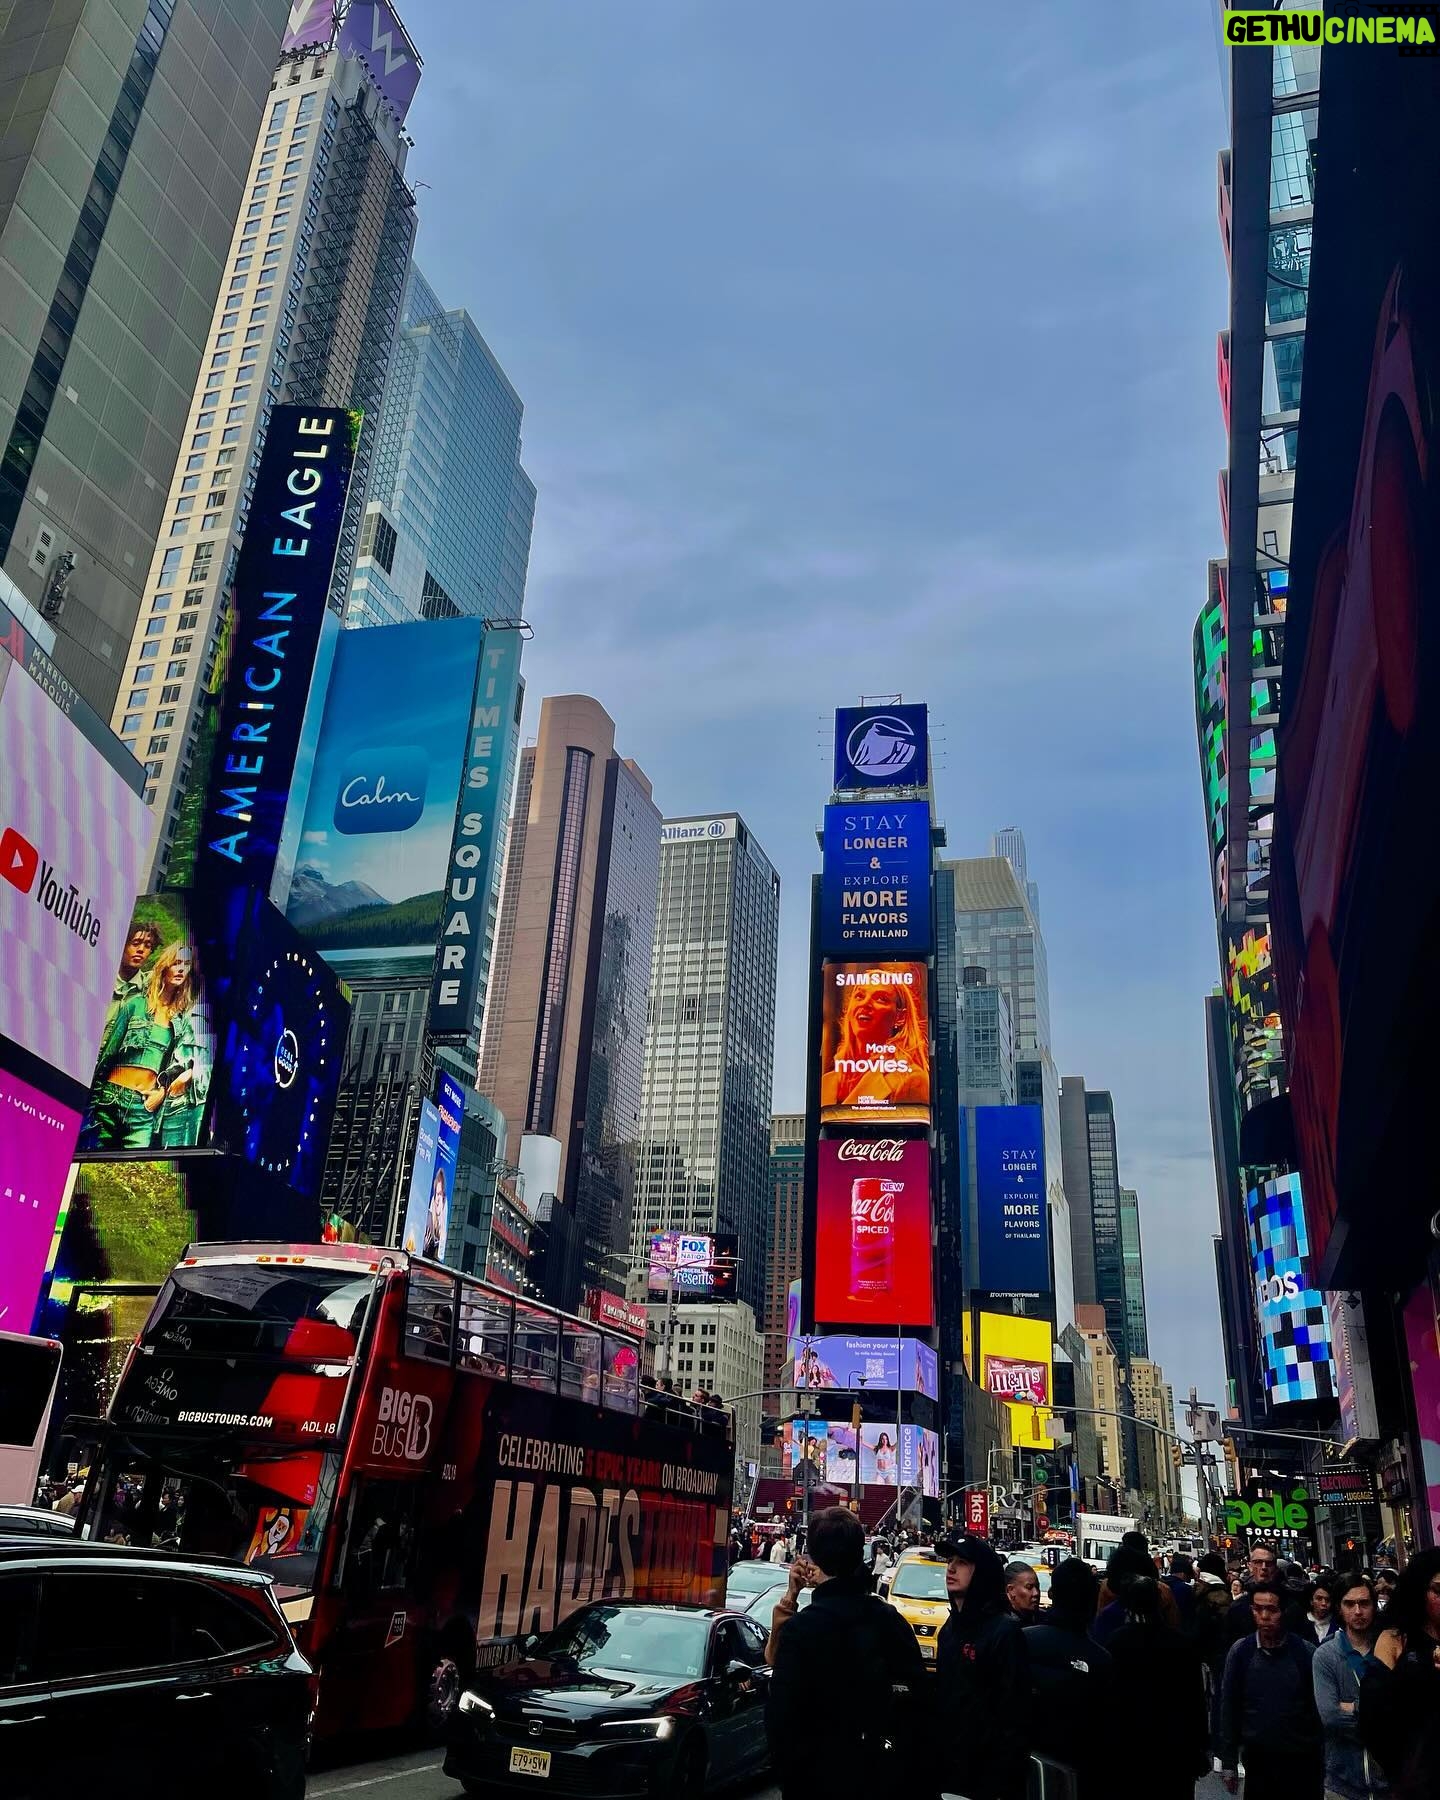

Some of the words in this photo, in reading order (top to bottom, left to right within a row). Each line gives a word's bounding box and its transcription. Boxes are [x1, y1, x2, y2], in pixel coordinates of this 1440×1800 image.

[208, 592, 297, 863] AMERICAN
[273, 416, 334, 557] EAGLE
[33, 647, 79, 705] MARRIOTT
[28, 662, 71, 714] MARQUIS
[468, 648, 504, 789] TIMES
[341, 776, 419, 807] Calm
[844, 814, 908, 831] STAY
[844, 836, 908, 850] LONGER
[869, 856, 881, 869] &
[844, 875, 909, 886] EXPLORE
[36, 860, 101, 948] YouTube
[842, 890, 908, 908] MORE
[438, 812, 483, 1006] SQUARE
[842, 912, 908, 925] FLAVORS
[842, 930, 855, 939] OF
[860, 929, 909, 938] THAILAND
[835, 972, 913, 986] SAMSUNG
[865, 1043, 896, 1054] More
[834, 1054, 913, 1073] movies.
[1002, 1149, 1037, 1160] STAY
[1002, 1163, 1037, 1171] LONGER
[1016, 1174, 1024, 1183] &
[881, 1183, 904, 1191] NEW
[1004, 1205, 1040, 1215] MORE
[856, 1225, 889, 1234] SPICED
[1004, 1220, 1040, 1228] FLAVORS
[681, 1240, 707, 1253] FOX
[846, 1341, 871, 1349] fashion
[378, 1387, 411, 1425] BIG
[177, 1411, 273, 1428] BIGBUSTOURS.COM
[301, 1421, 321, 1433] ADL
[324, 1422, 336, 1434] 18
[372, 1424, 406, 1458] BUS
[902, 1427, 911, 1475] florence
[498, 1433, 584, 1476] CELEBRATING
[662, 1463, 675, 1489] ON
[675, 1466, 718, 1495] BROADWAY
[971, 1494, 984, 1523] tkts
[1089, 1523, 1102, 1531] STAR
[1246, 1527, 1299, 1538] SOCCER
